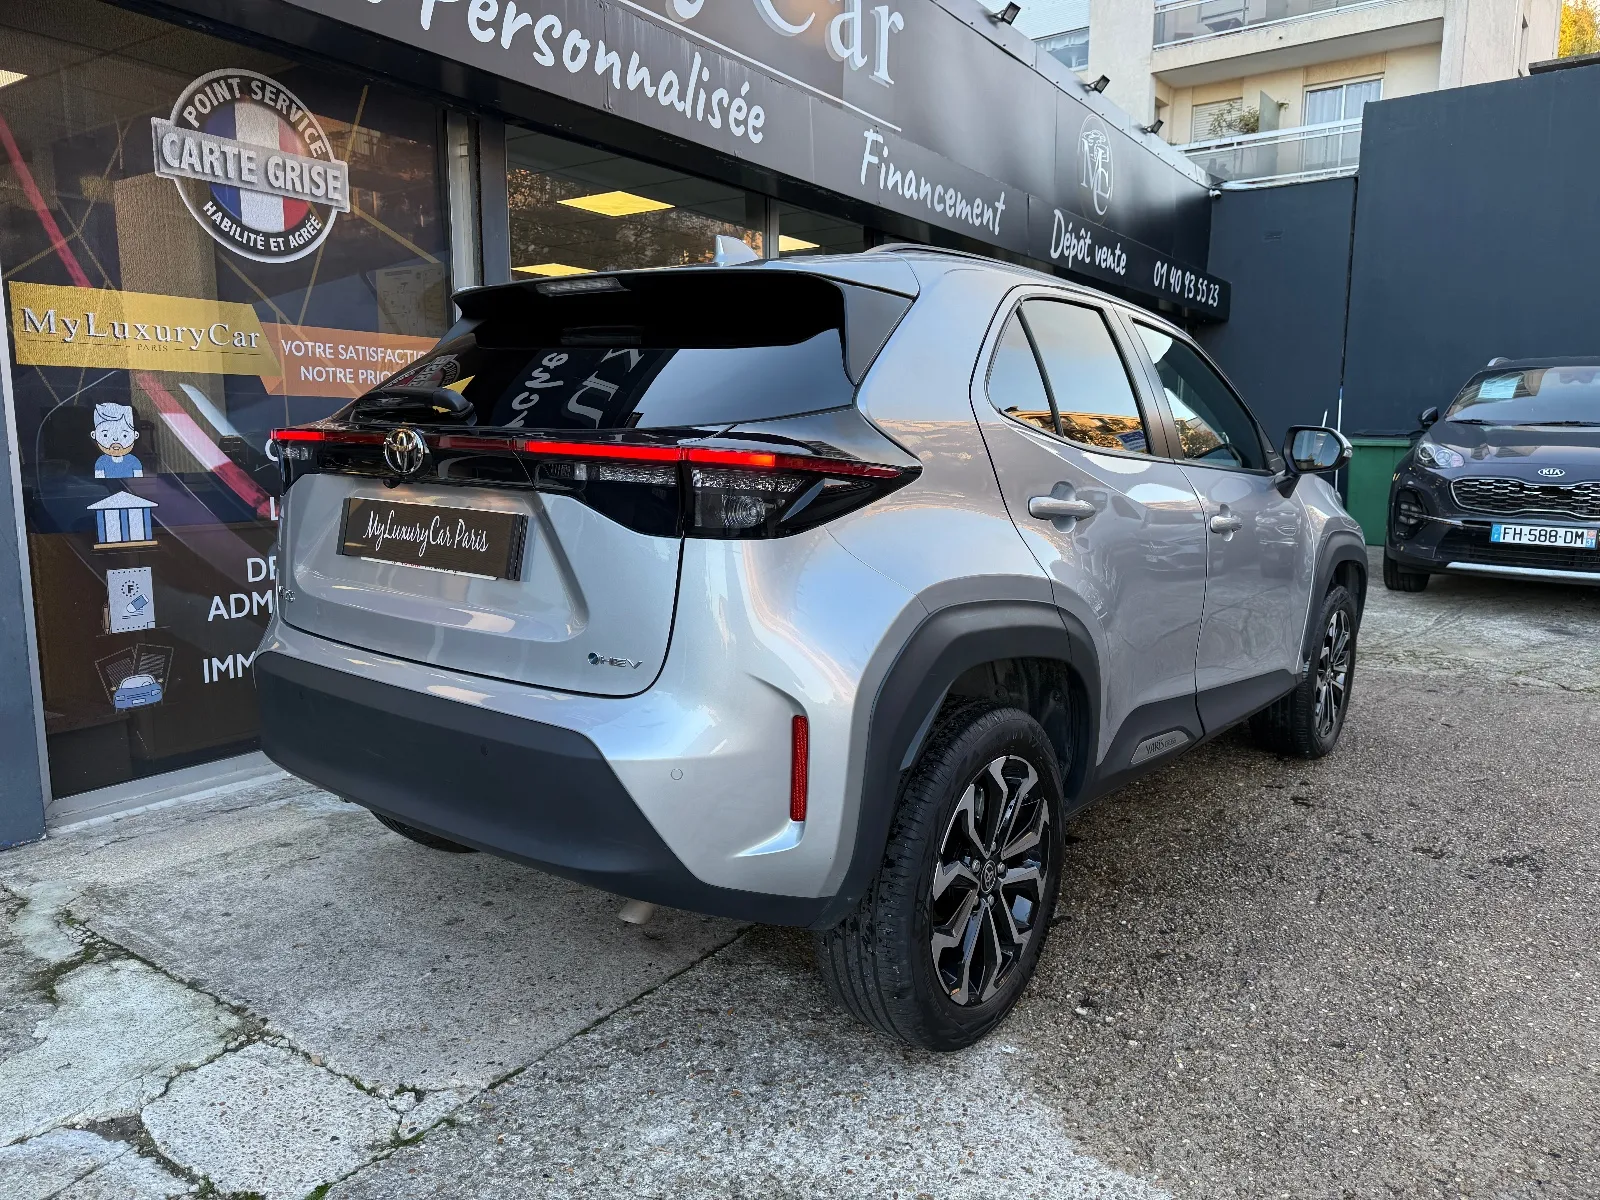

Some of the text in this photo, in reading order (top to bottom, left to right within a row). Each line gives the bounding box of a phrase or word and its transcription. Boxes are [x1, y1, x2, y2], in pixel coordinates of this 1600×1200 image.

[182, 77, 326, 158] POINT SERVICE
[162, 132, 342, 201] CARTE GRISE
[860, 128, 1006, 236] Financement
[202, 200, 322, 252] HABILITÉ ET AGRÉÉ
[1050, 208, 1127, 276] Dépôt vente
[1153, 260, 1220, 308] 01 40 93 55 23
[20, 306, 261, 350] MyLuxuryCar
[137, 343, 168, 352] PARIS
[280, 339, 334, 359] VOTRE
[300, 365, 355, 384] NOTRE
[359, 369, 397, 386] PRIO
[1502, 526, 1585, 545] FH-588-DM
[246, 555, 277, 583] DE
[127, 584, 134, 594] F
[207, 588, 273, 622] ADM
[202, 650, 257, 684] IMM
